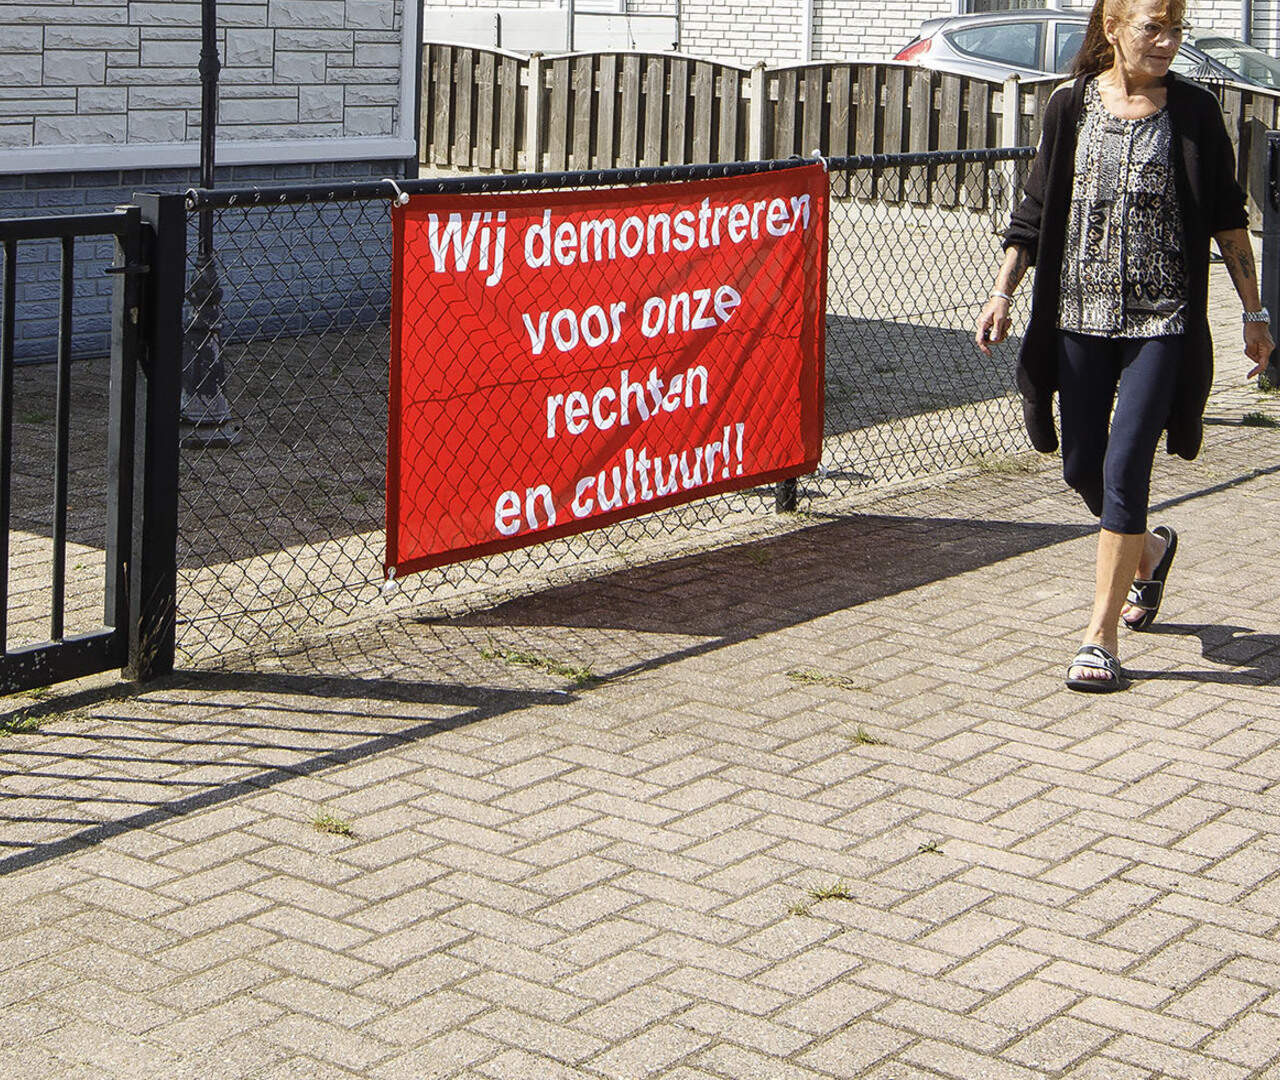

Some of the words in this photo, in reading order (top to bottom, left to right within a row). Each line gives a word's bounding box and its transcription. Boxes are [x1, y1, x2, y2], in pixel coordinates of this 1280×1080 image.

[427, 211, 507, 287] Wij
[524, 193, 811, 268] demonstreren
[522, 301, 628, 355] voor
[641, 284, 742, 339] onze
[546, 364, 709, 439] rechten
[494, 483, 556, 536] en
[571, 422, 746, 518] cultuur!!
